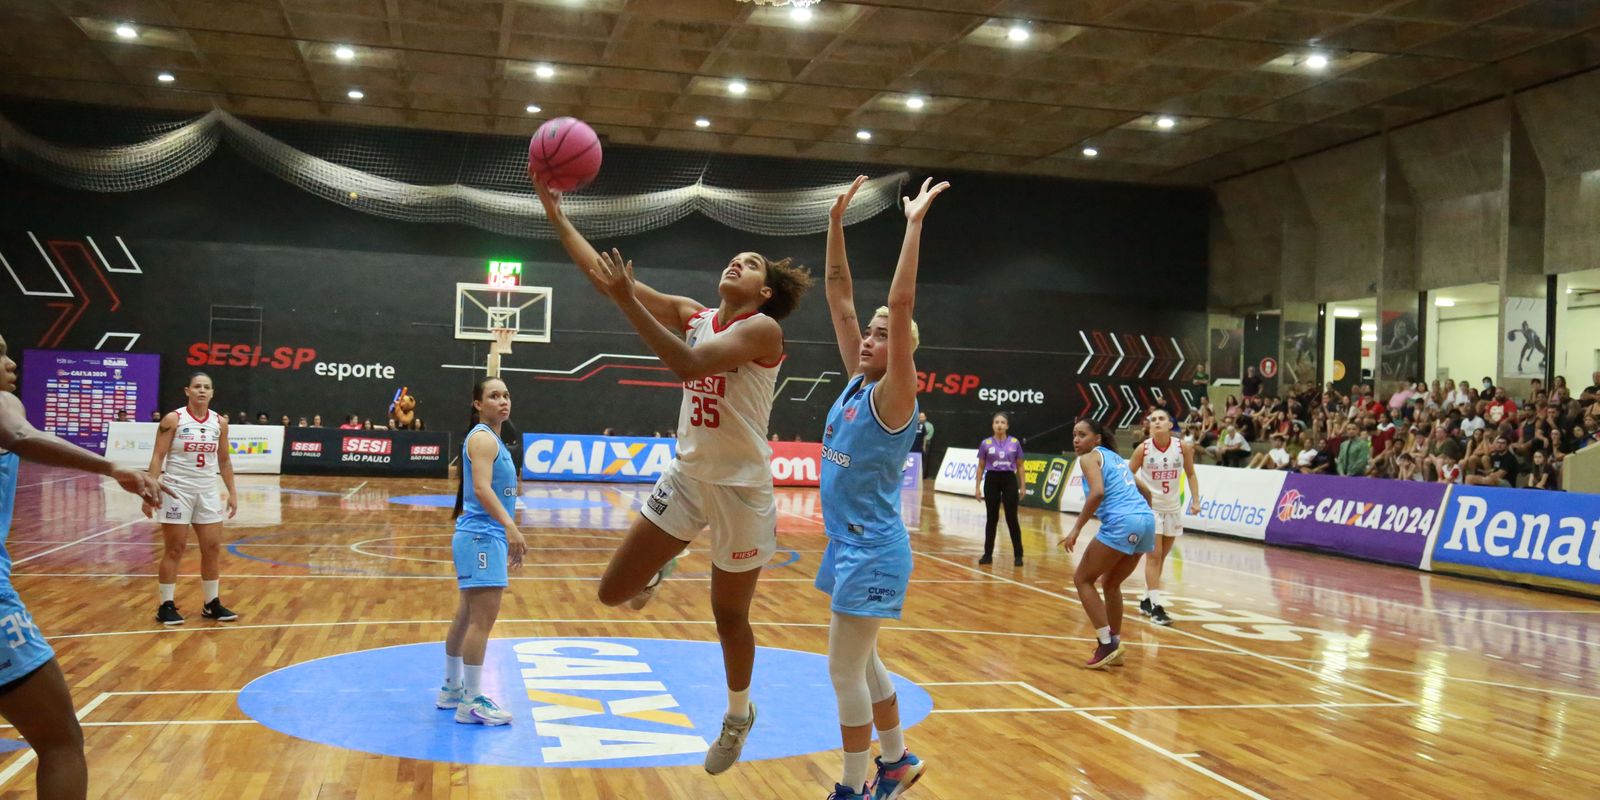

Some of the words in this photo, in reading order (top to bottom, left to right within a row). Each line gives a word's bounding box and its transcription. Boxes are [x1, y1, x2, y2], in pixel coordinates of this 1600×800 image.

[187, 341, 316, 370] SESI-SP
[314, 357, 396, 381] esporte
[978, 387, 1044, 405] esporte
[690, 396, 720, 428] 35
[187, 443, 216, 452] SESI
[294, 442, 320, 451] SESI
[347, 438, 388, 453] SESI
[413, 446, 437, 455] SESI
[196, 454, 206, 468] 9
[341, 453, 361, 462] SÃO
[361, 454, 391, 463] PAULO
[524, 439, 674, 476] CAIXA
[944, 461, 977, 481] CURSO
[1154, 471, 1177, 480] SESI
[1162, 481, 1170, 494] 5
[1314, 497, 1382, 529] CAIXA
[1380, 504, 1435, 536] 2024
[478, 552, 488, 569] 9
[868, 586, 896, 597] CURSO
[512, 640, 710, 763] CAIXA
